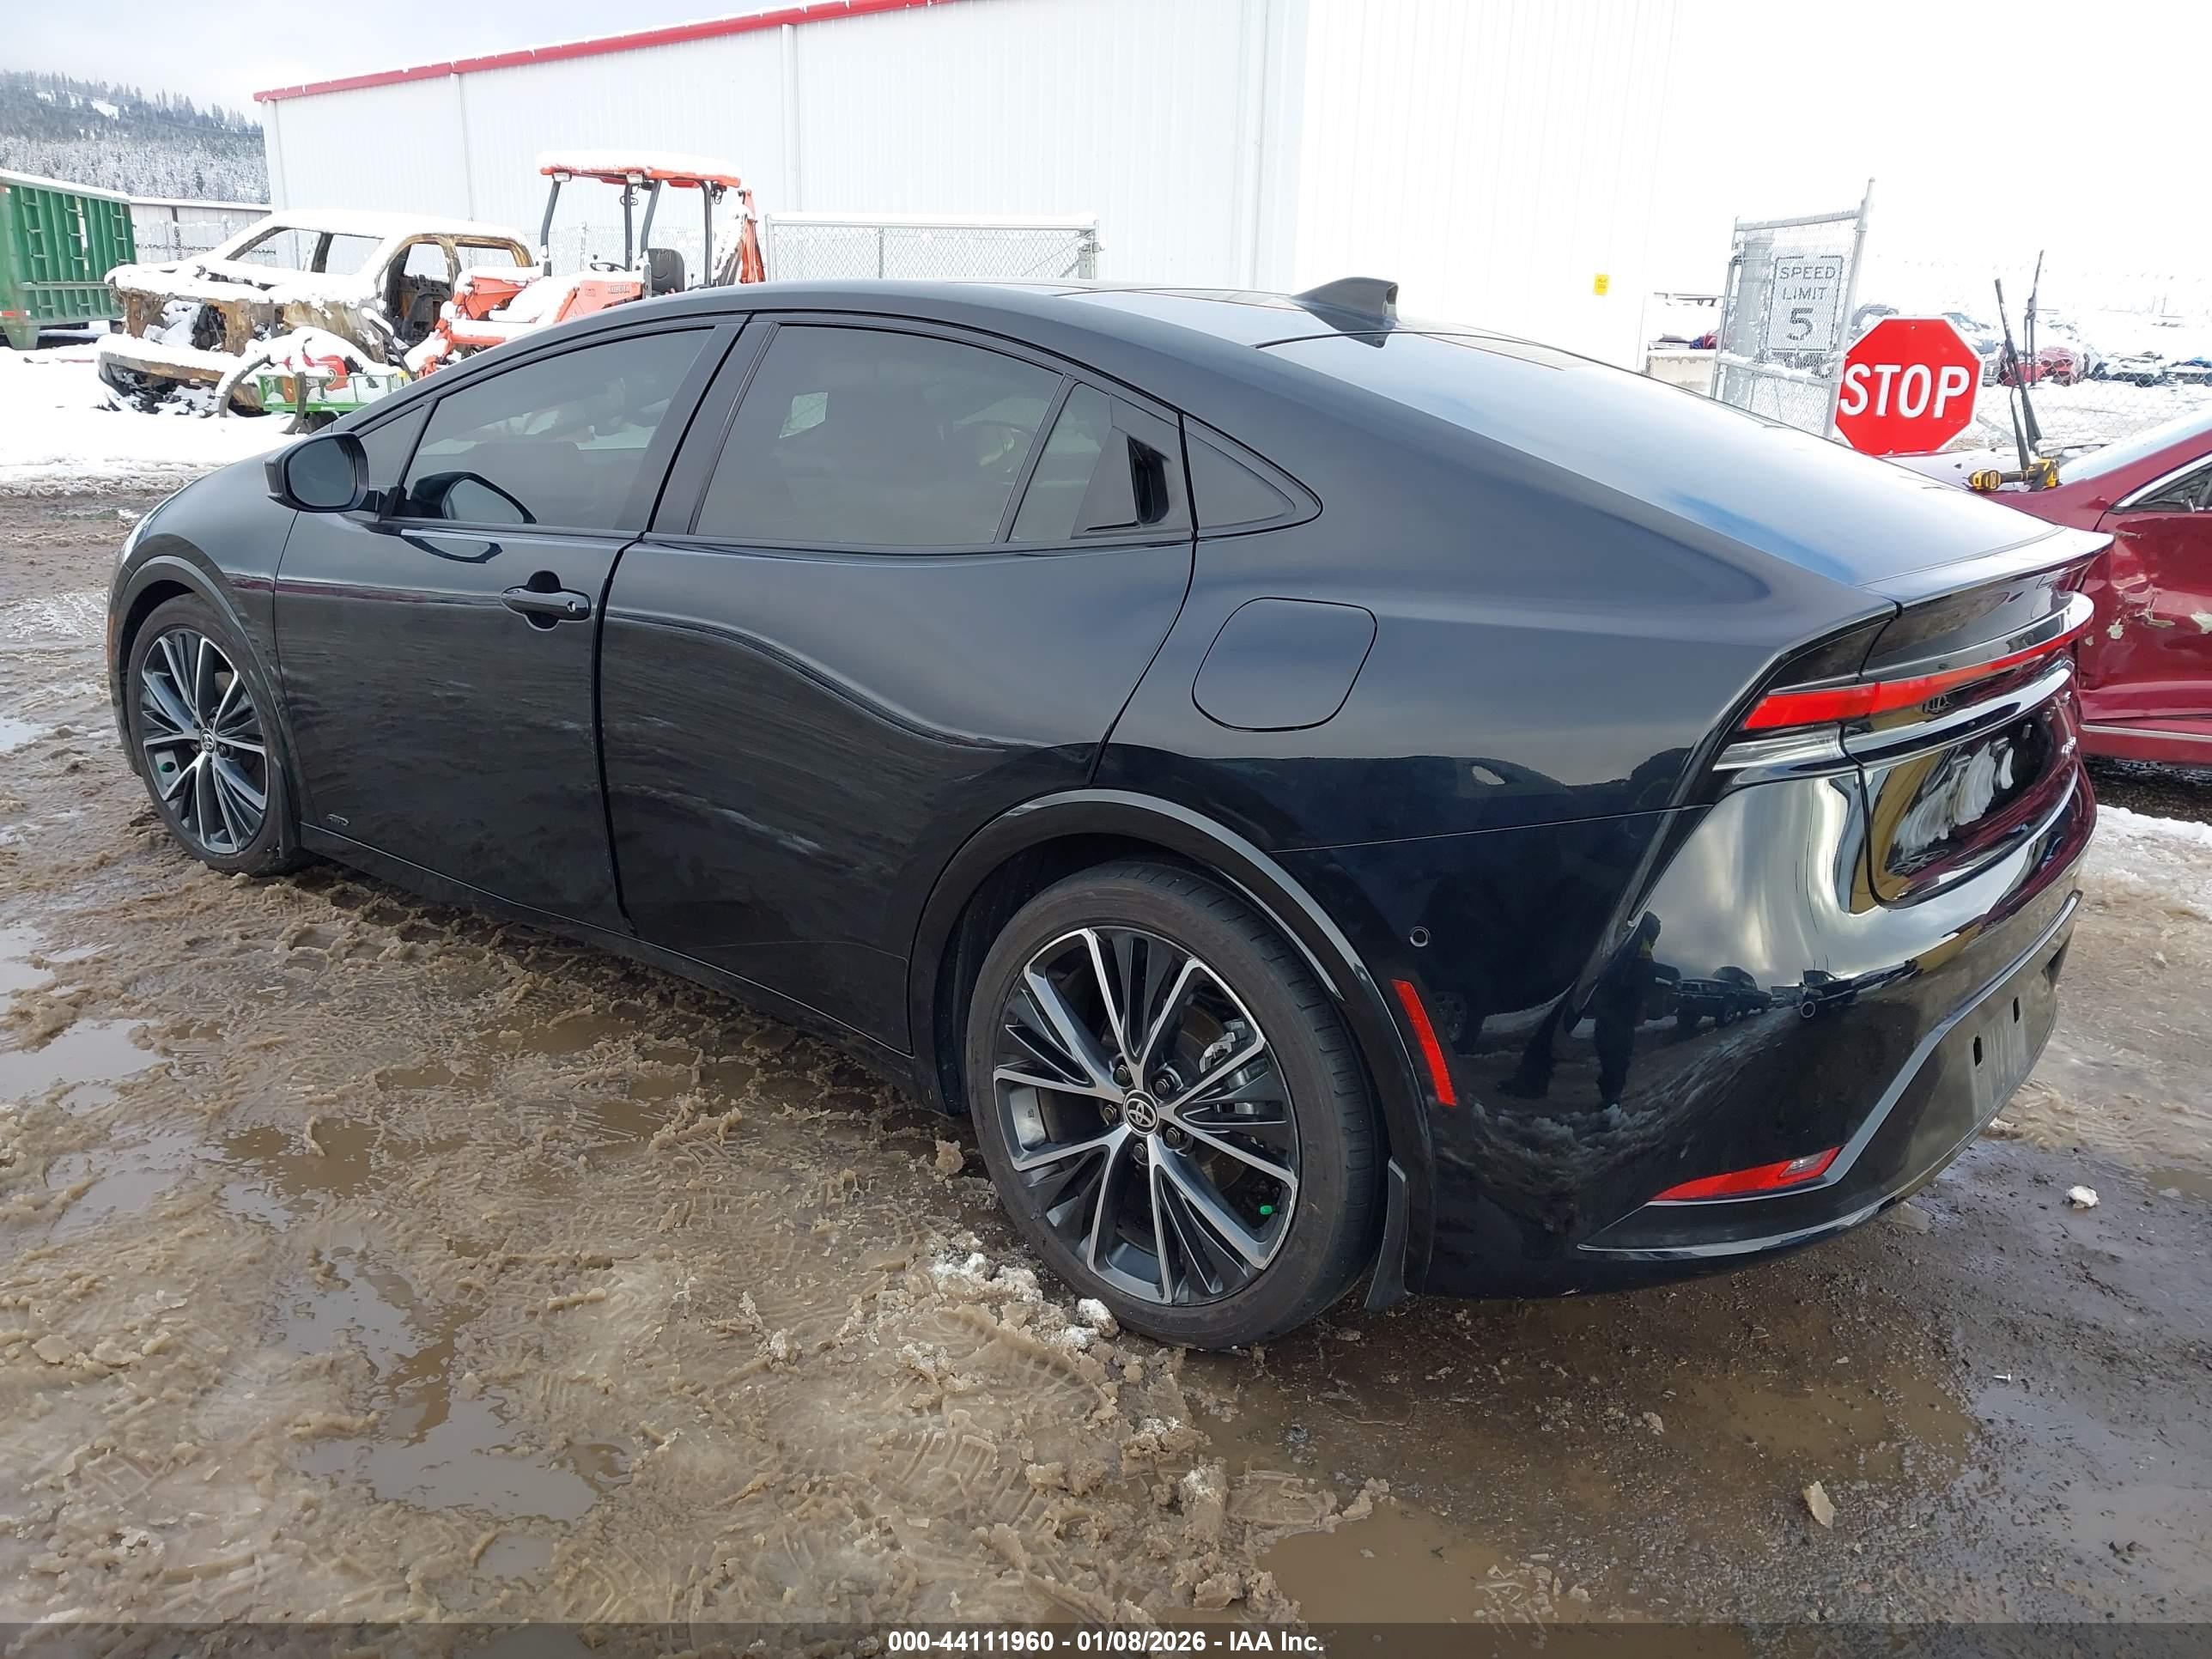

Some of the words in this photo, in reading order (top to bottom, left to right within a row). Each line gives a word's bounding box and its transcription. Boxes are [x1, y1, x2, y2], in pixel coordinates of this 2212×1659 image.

[1779, 266, 1836, 280] SPEED
[1782, 287, 1827, 300] LIMIT
[1786, 307, 1814, 340] 5
[1840, 363, 1971, 418] STOP
